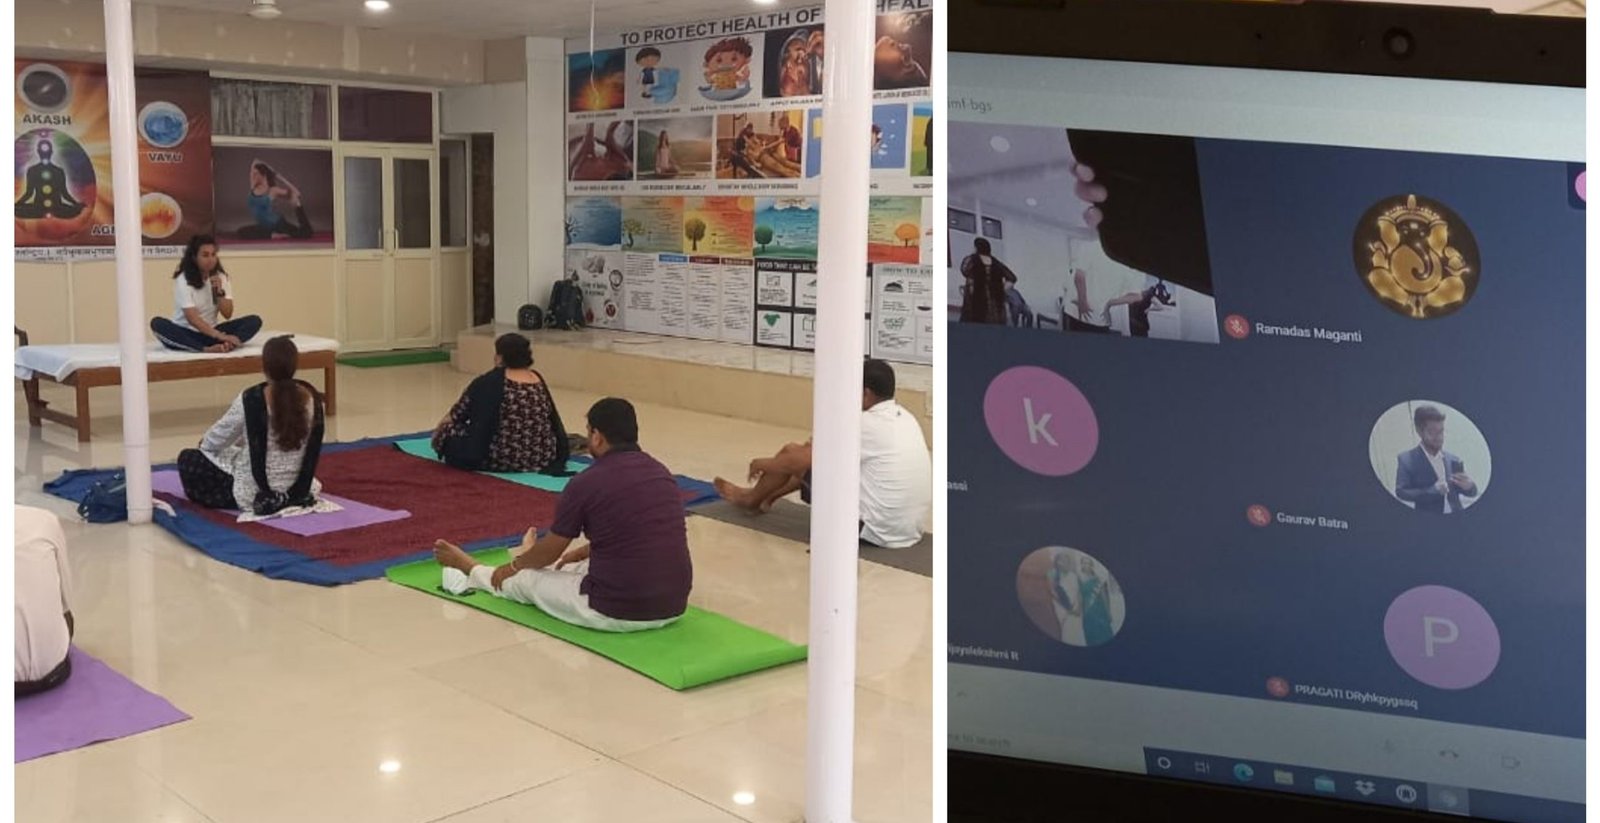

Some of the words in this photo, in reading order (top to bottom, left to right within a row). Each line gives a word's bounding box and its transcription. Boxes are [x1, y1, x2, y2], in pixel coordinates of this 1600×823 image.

[620, 33, 639, 46] TO
[644, 22, 717, 43] PROTECT
[722, 13, 789, 33] HEALTH
[796, 8, 820, 23] OF
[23, 113, 72, 126] AKASH
[148, 152, 183, 164] VAYU
[1256, 322, 1311, 338] Ramadas
[1313, 328, 1362, 343] Maganti
[1023, 397, 1058, 447] k
[1276, 512, 1316, 527] Gaurav
[1318, 516, 1349, 530] Batra
[1423, 616, 1460, 657] P
[1296, 684, 1343, 699] PRAGATI
